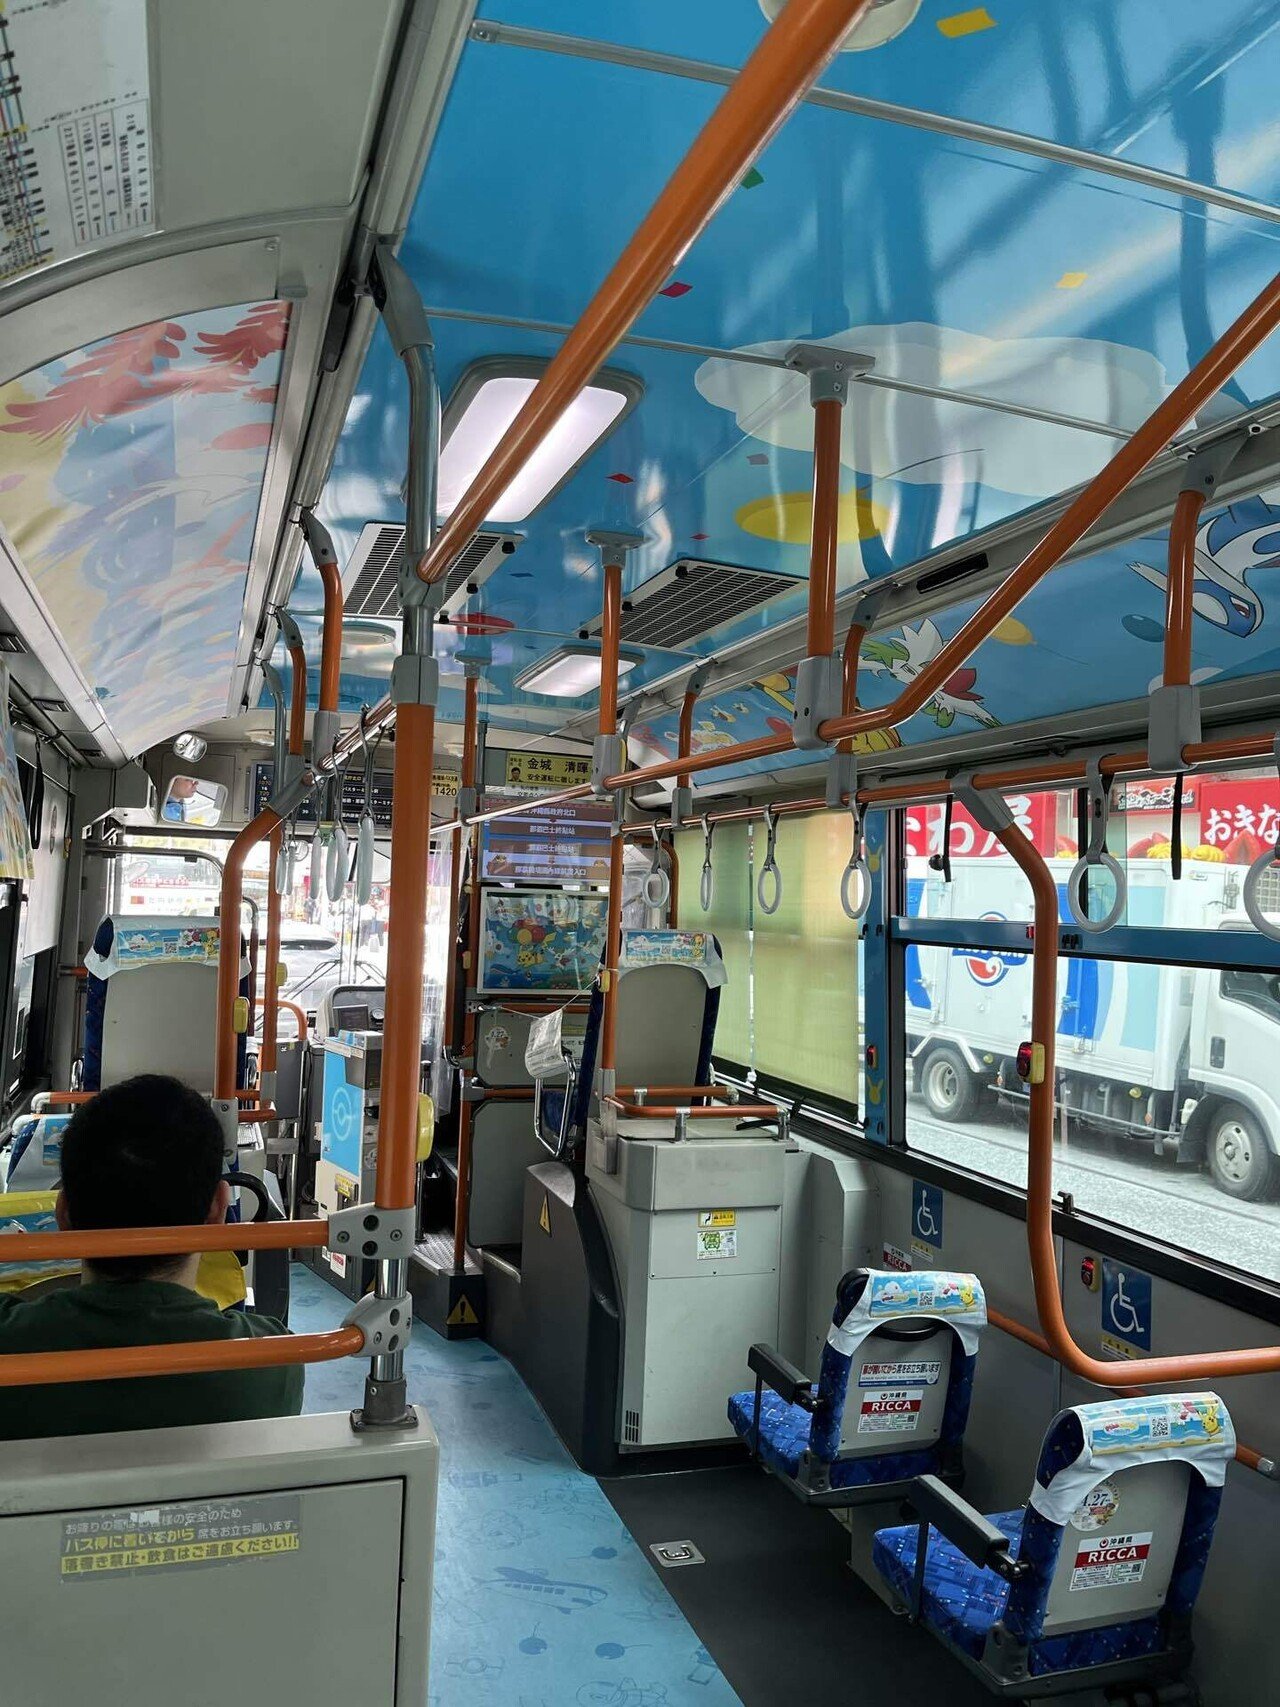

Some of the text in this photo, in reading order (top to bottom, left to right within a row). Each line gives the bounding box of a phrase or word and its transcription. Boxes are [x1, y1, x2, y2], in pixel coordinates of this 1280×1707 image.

[435, 787, 457, 796] 1420
[887, 1254, 908, 1271] RICCA
[871, 1401, 912, 1411] RICCA
[1088, 1547, 1138, 1563] RICCA
